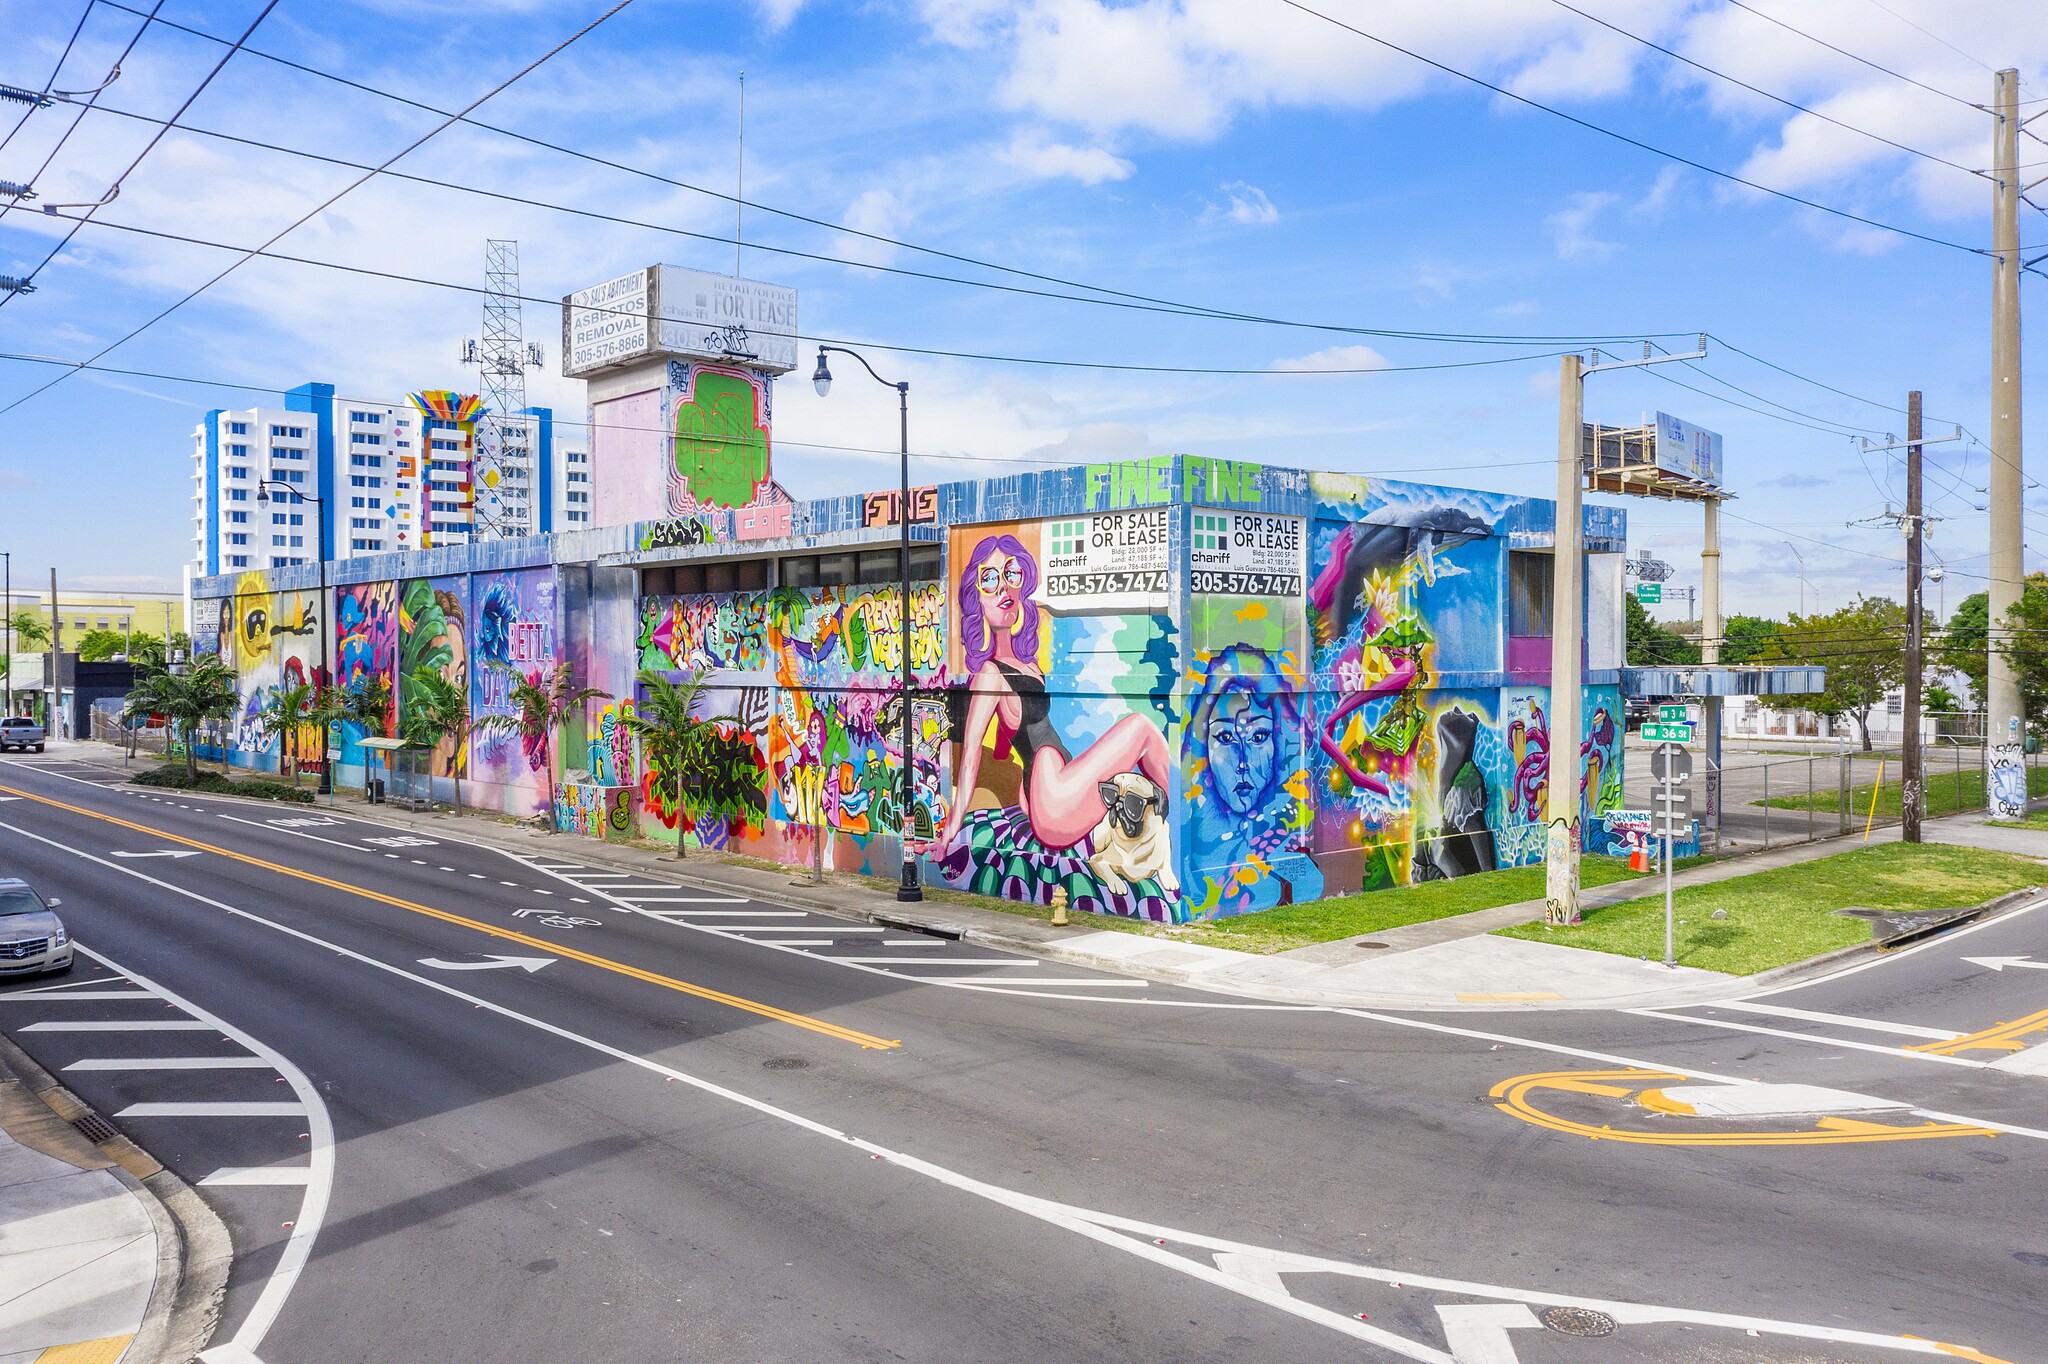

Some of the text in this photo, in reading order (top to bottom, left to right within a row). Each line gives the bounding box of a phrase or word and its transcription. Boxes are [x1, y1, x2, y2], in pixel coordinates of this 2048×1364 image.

[607, 272, 644, 300] ABATEMENT
[574, 297, 644, 329] ASBESTOS
[714, 291, 794, 326] FOR LEASE
[577, 317, 640, 344] REMOVAL
[575, 333, 644, 364] 305-576-8866
[1085, 454, 1172, 509] FINE
[1183, 454, 1261, 502] FINE
[864, 486, 936, 527] FINE
[1092, 511, 1167, 532] FOR SALE
[1234, 516, 1299, 535] FOR SALE
[1092, 529, 1167, 548] OR LEASE
[1234, 532, 1299, 550] OR LEASE
[1049, 555, 1087, 568] chariff
[1191, 551, 1230, 563] chariff
[1245, 565, 1267, 573] Guevara
[1048, 572, 1168, 595] 305-576-7474
[1191, 572, 1300, 595] 305-576-7474
[508, 622, 553, 661] BETTA
[1671, 709, 1676, 719] 3
[1644, 728, 1687, 738] NW 36 St
[266, 815, 346, 828] ONLY
[361, 835, 440, 849] BUS
